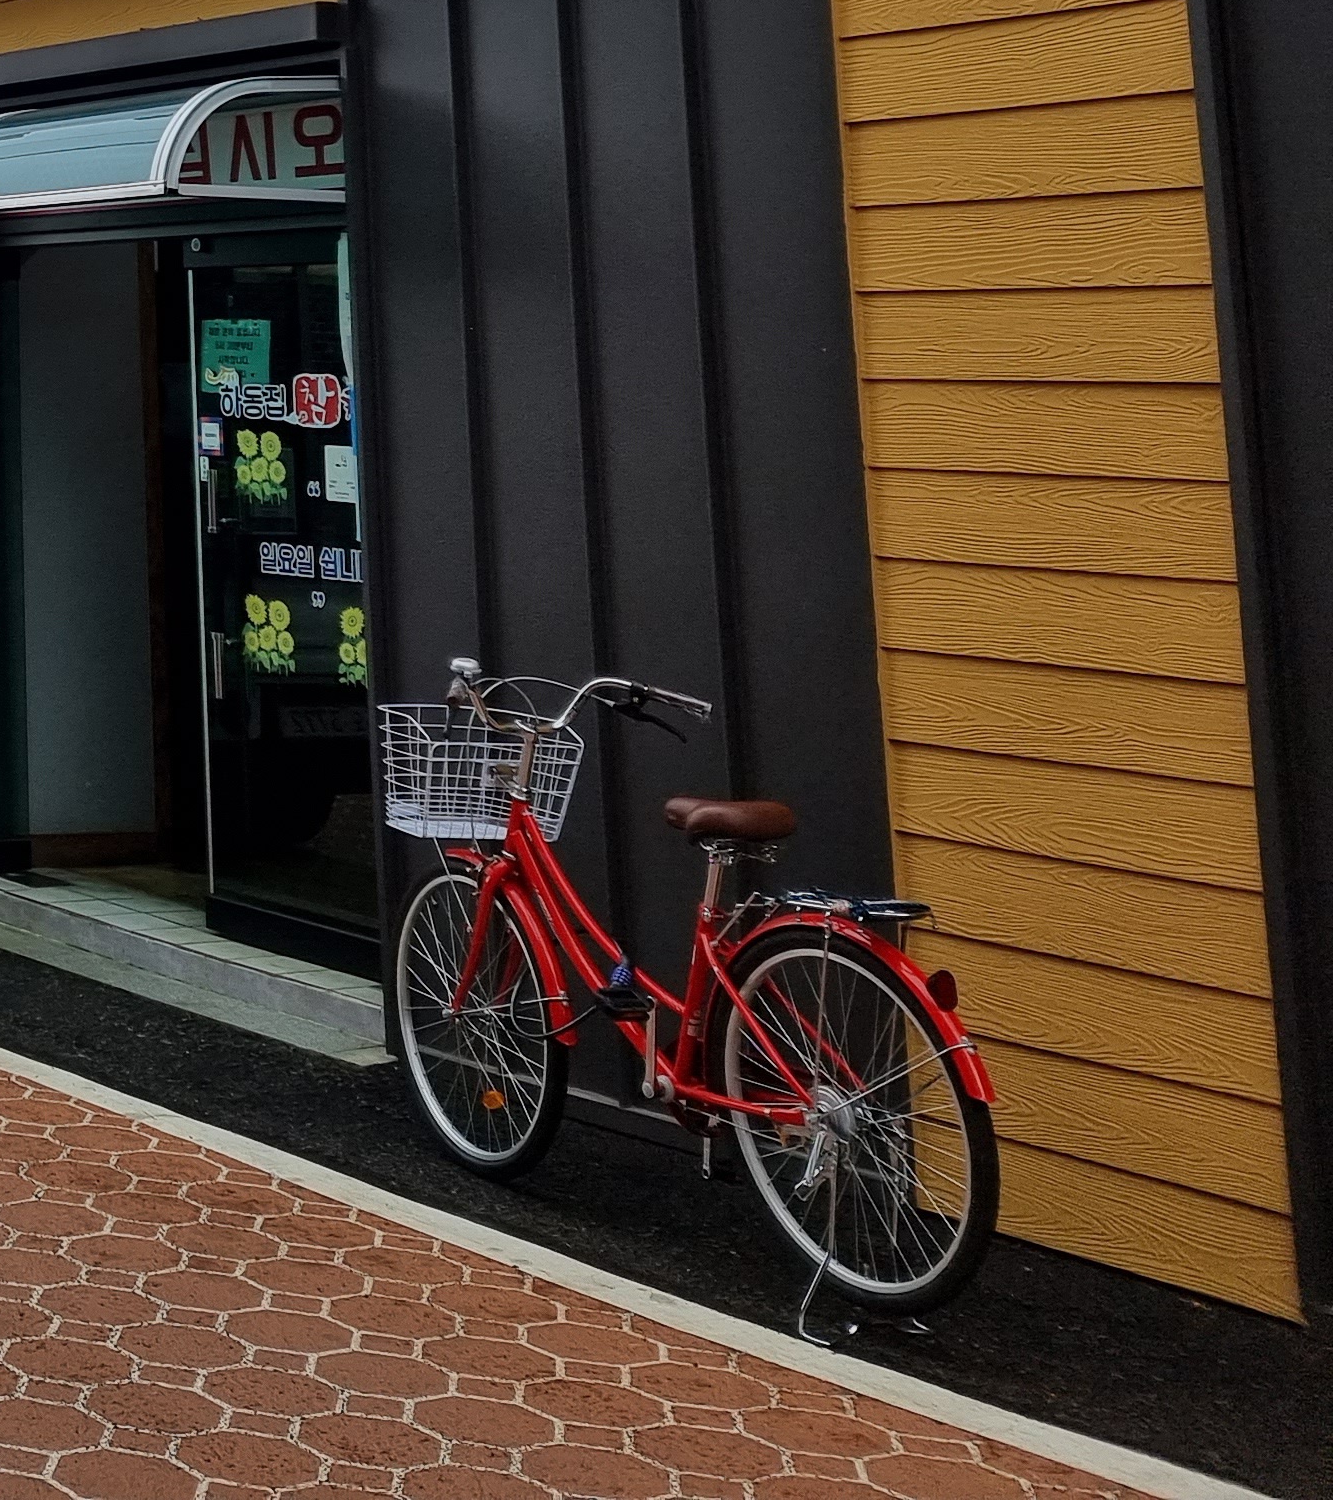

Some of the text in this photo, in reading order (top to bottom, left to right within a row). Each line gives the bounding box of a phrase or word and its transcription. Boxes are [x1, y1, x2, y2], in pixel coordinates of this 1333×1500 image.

[221, 384, 287, 420] 하동집
[259, 541, 364, 583] 일요일 쉽니
